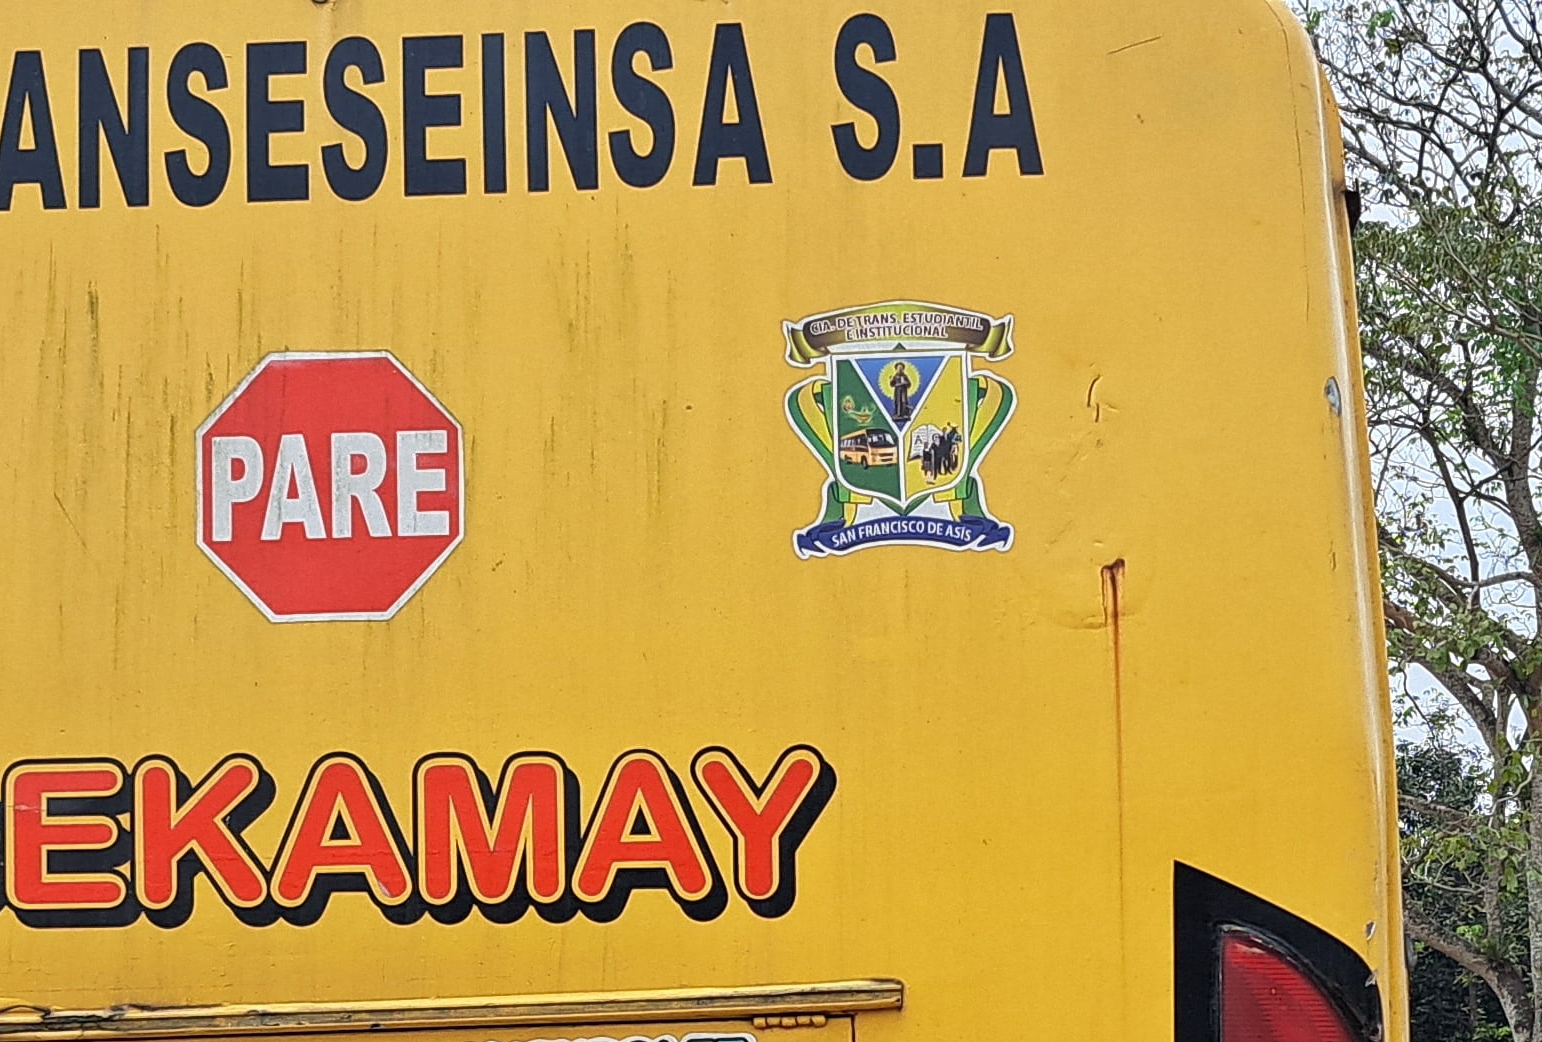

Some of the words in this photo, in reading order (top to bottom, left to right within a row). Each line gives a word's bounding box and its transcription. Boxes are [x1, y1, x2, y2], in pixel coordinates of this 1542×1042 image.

[831, 12, 1044, 182] S.A
[837, 317, 853, 329] DE
[903, 312, 984, 331] ESTUDIANTIL
[856, 325, 948, 339] INSTITUCIONAL
[211, 430, 450, 541] PARE
[831, 528, 856, 547] SAN
[858, 520, 925, 539] FRANCISCO
[927, 521, 944, 535] DE
